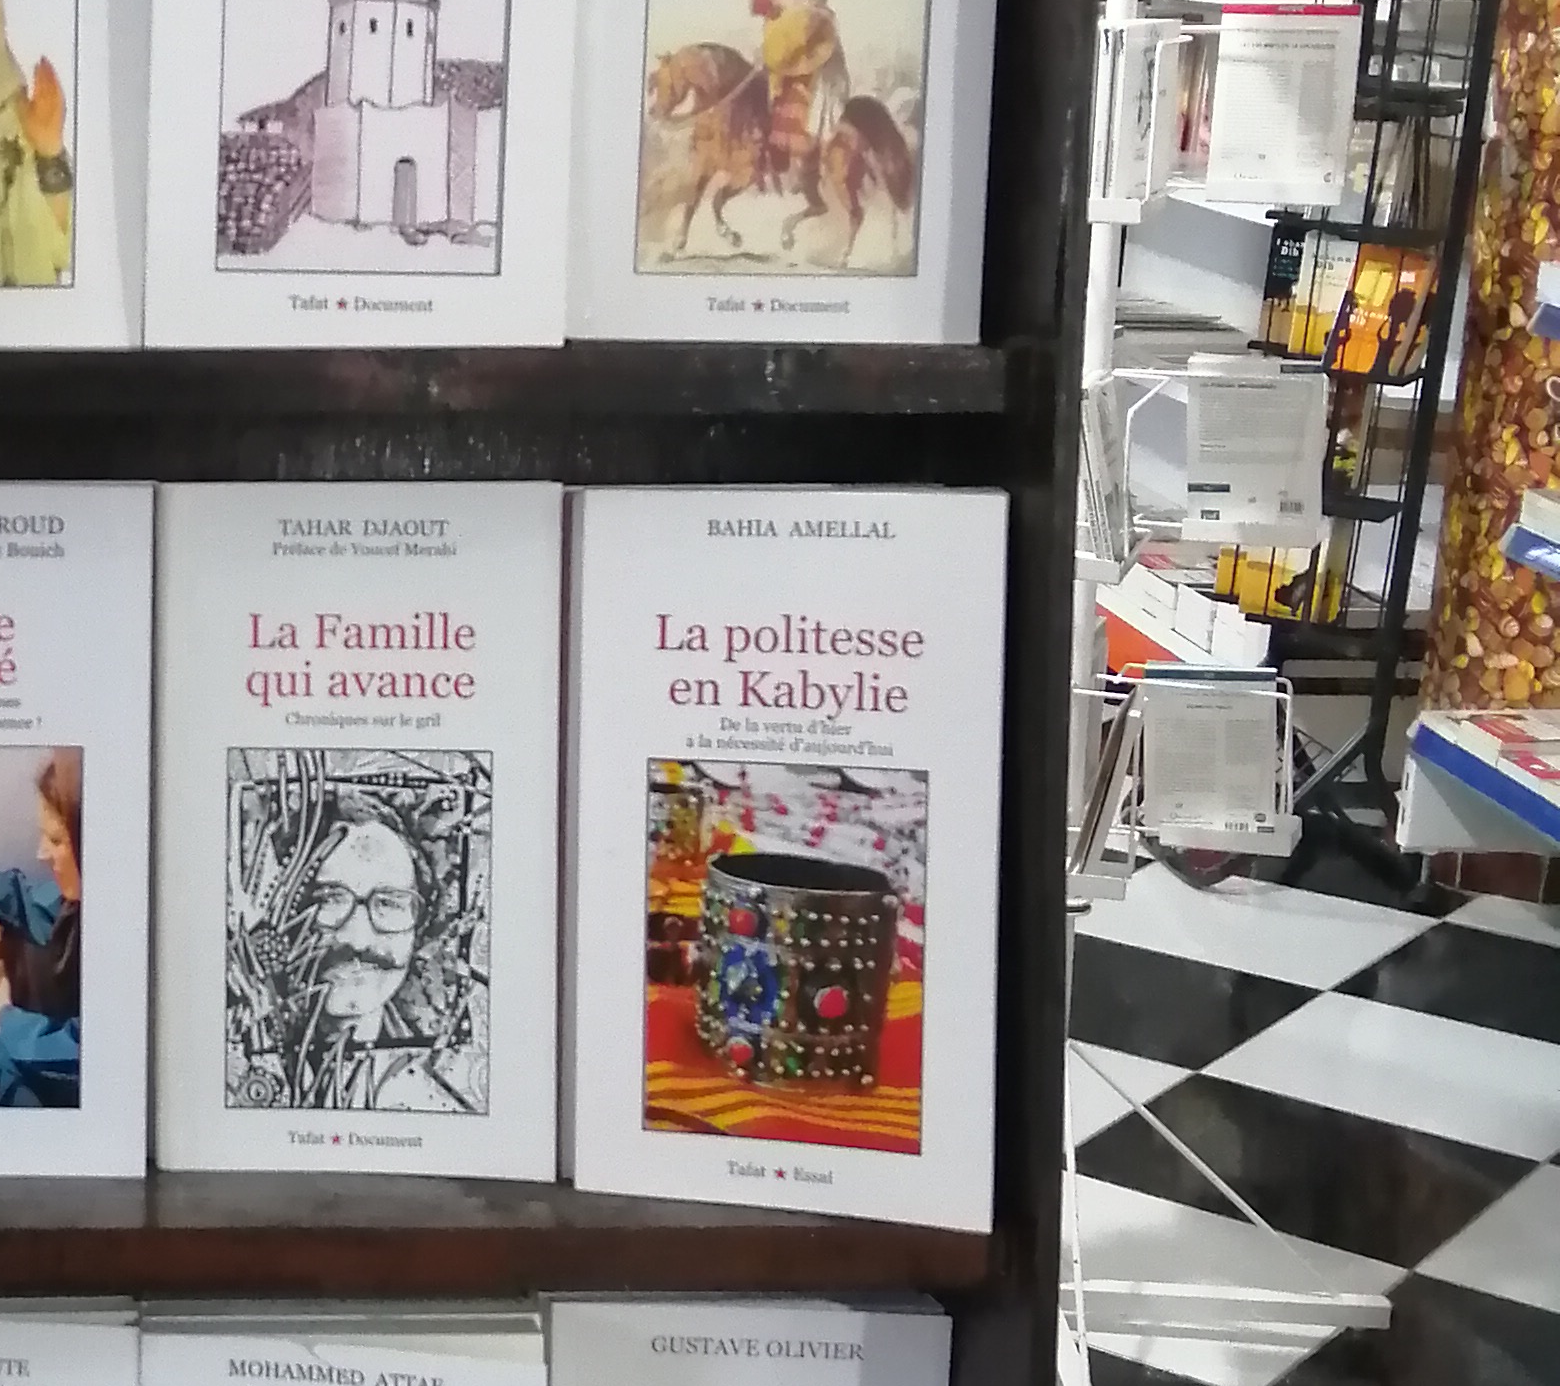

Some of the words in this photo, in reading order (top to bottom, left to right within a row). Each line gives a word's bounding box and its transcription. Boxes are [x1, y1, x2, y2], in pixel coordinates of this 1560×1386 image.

[278, 518, 352, 537] TAHAR
[362, 518, 450, 537] DJAOUT
[707, 519, 778, 537] BAHIA
[790, 520, 896, 539] AMELLAL
[248, 613, 299, 650] La
[315, 612, 476, 651] Famille
[656, 613, 709, 652] La
[723, 612, 924, 663] politesse
[246, 661, 313, 707] qui
[328, 671, 476, 699] avance
[669, 677, 721, 706] en
[738, 669, 909, 720] Kabylie
[651, 1335, 760, 1357] GUSTAVE
[767, 1339, 864, 1361] OLIVIER
[228, 1358, 365, 1386] MOHAMMED
